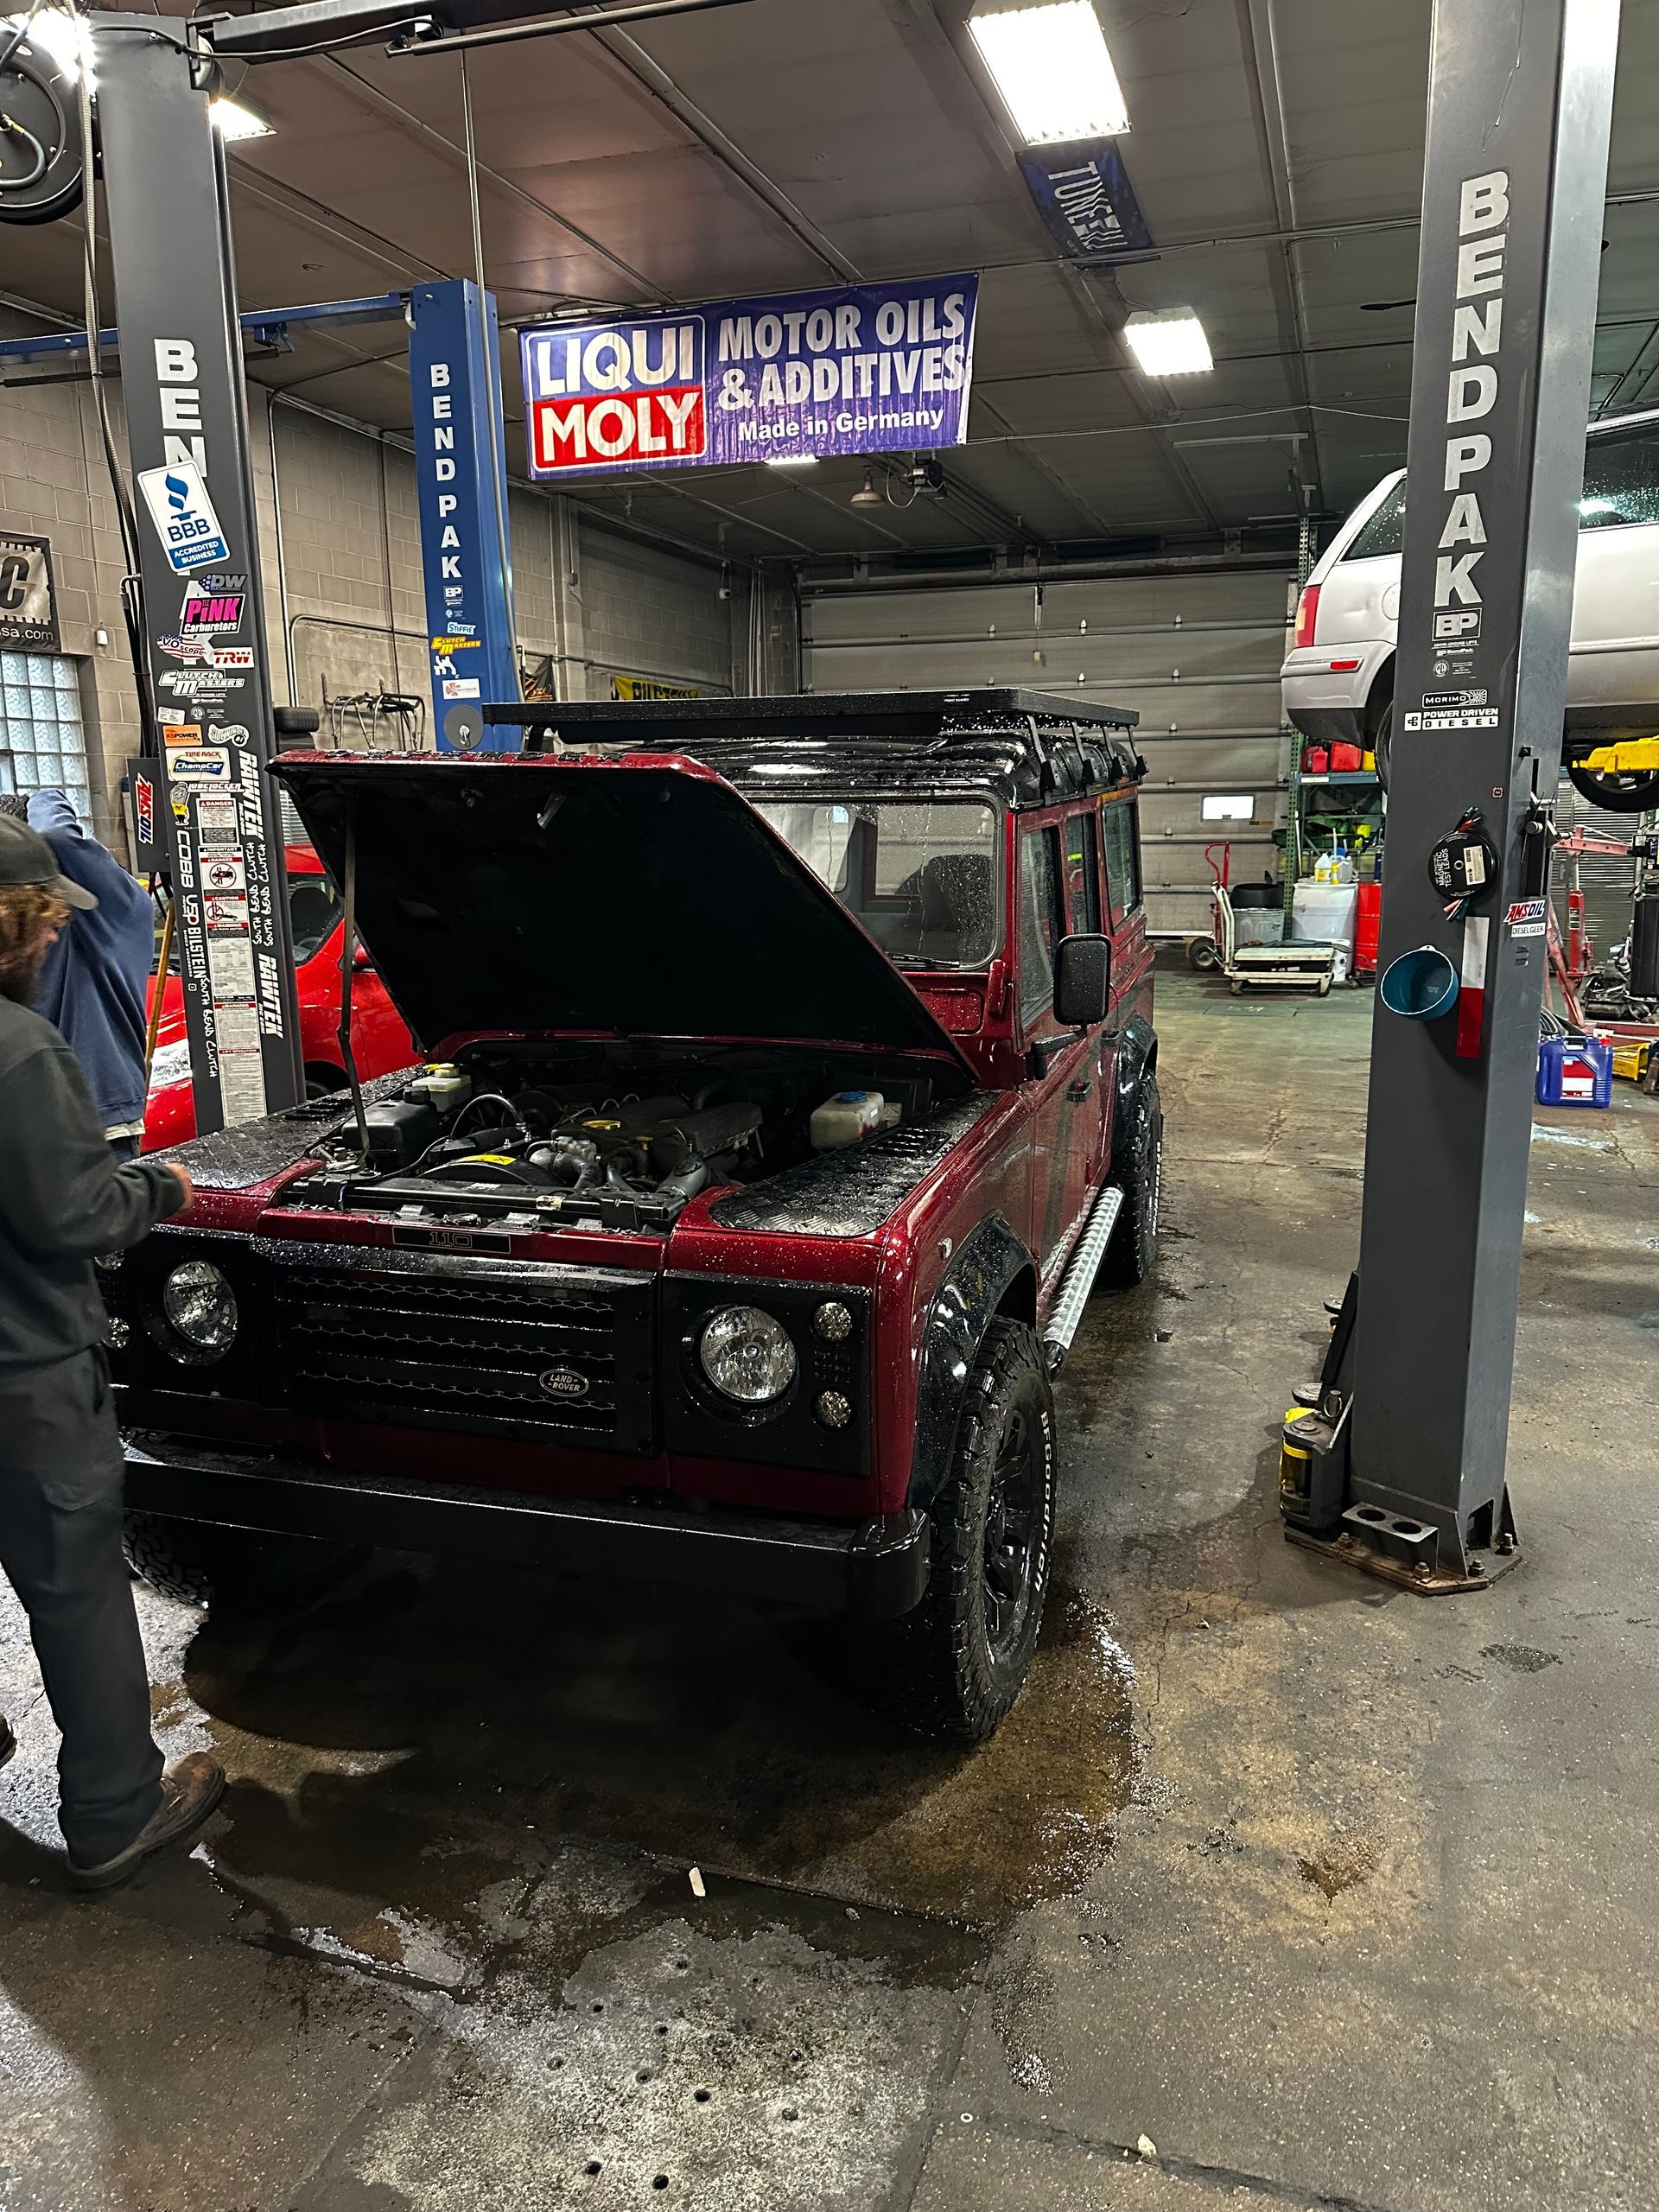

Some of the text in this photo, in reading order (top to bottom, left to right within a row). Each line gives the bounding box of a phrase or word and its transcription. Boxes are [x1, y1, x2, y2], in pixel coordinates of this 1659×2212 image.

[718, 294, 965, 361] MOTOR OILS
[537, 325, 694, 396] LIQUI
[718, 345, 966, 410] & ADDITIVES
[1434, 171, 1509, 607] BENDPAK
[541, 391, 700, 461] MOLY
[739, 410, 944, 441] Made in Germany
[430, 363, 462, 578] BENDPAK
[168, 518, 211, 542] BBB
[174, 540, 219, 558] ACCREDITED
[181, 549, 217, 564] BUSINESS
[210, 575, 245, 588] DW
[445, 588, 461, 597] BP
[183, 622, 237, 633] Carburetors
[1435, 613, 1478, 637] BP
[180, 645, 204, 655] scope
[432, 637, 466, 649] CLUTCH
[440, 641, 481, 655] MASTERS
[213, 652, 251, 664] TRW
[161, 671, 220, 684] CLUTCH
[174, 678, 244, 695] MASTERS
[1423, 708, 1499, 719] POWER DRIVEN
[1425, 718, 1496, 728] DIESEL
[175, 762, 224, 771] ChampCar
[201, 750, 222, 760] RACK
[239, 750, 264, 841] RAWTEK
[137, 776, 152, 842] AMSOIL
[176, 830, 194, 889] COBB
[1436, 851, 1445, 887] MAGNETIC
[245, 842, 262, 945] SOUTH BEND CLUTCH
[257, 843, 274, 947] SOUTH BEND CLUTCH
[1506, 902, 1544, 924] AMSOIL
[188, 926, 206, 980] BILSTEIN
[258, 953, 283, 1039] RAWTEK
[200, 976, 219, 1078] SOUTH BEND CLUTCH
[429, 1230, 474, 1249] 110
[1035, 1410, 1052, 1592] BFGoodrich
